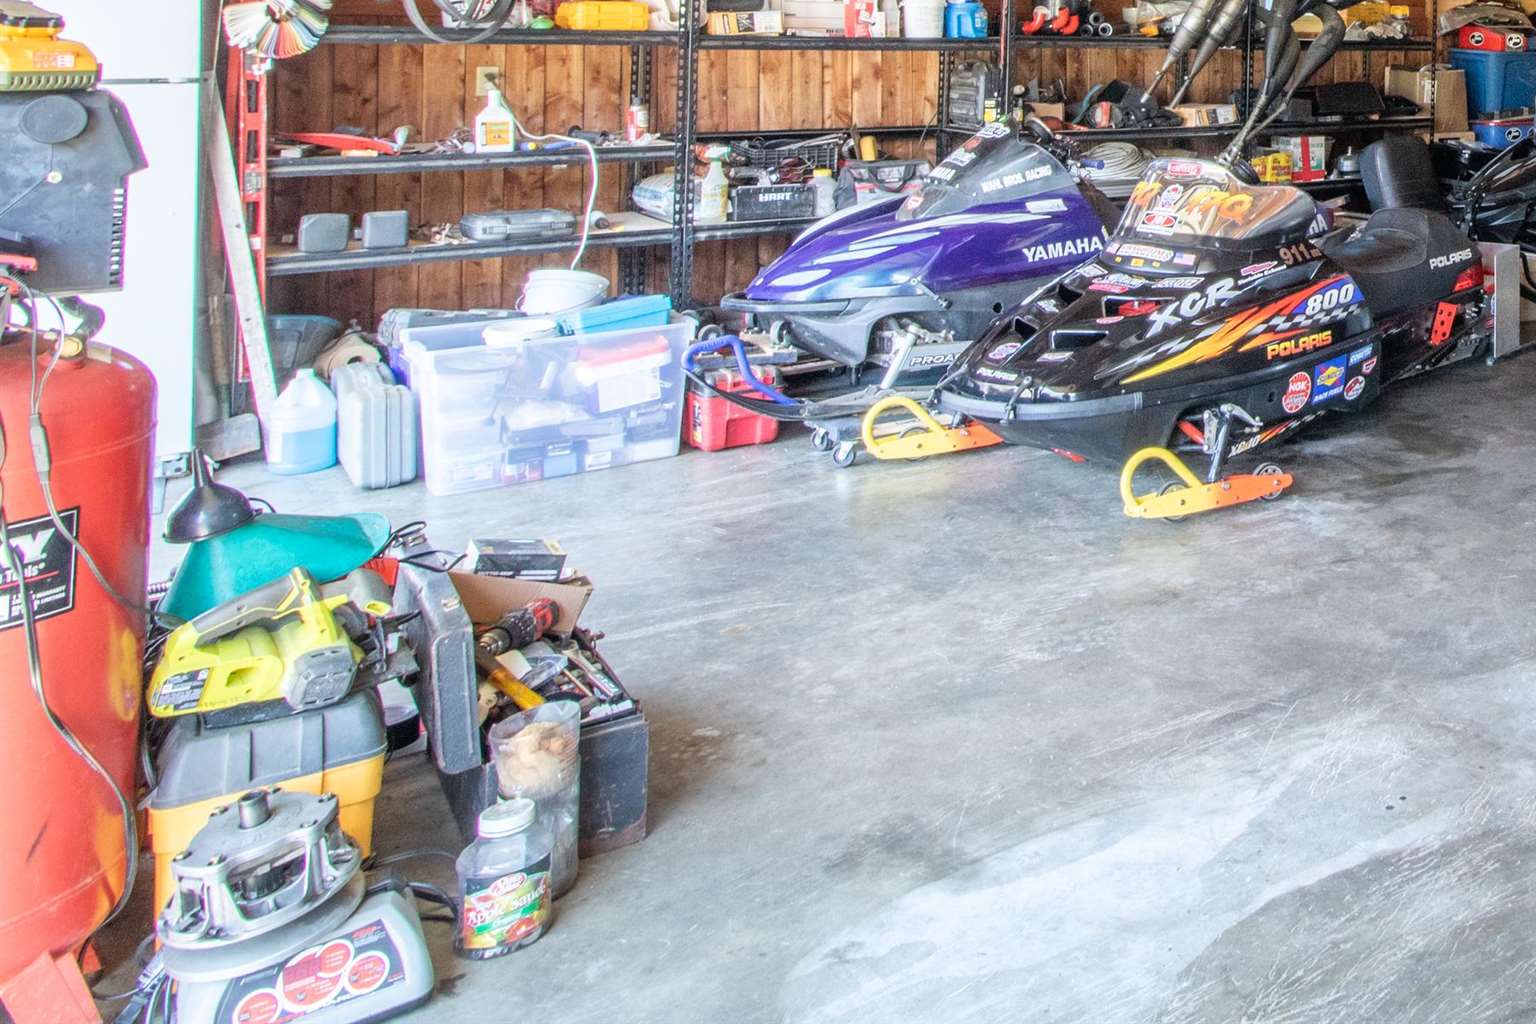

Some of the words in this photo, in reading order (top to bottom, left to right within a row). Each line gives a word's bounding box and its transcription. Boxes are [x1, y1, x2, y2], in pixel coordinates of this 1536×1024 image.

[758, 192, 791, 203] HART
[1022, 236, 1104, 263] YAMAHA
[1279, 243, 1311, 265] 911
[1429, 248, 1473, 270] POLARIS
[1146, 278, 1241, 338] XCR
[1305, 283, 1355, 316] 800
[1266, 330, 1333, 361] POLARIS
[1288, 379, 1308, 392] NGK
